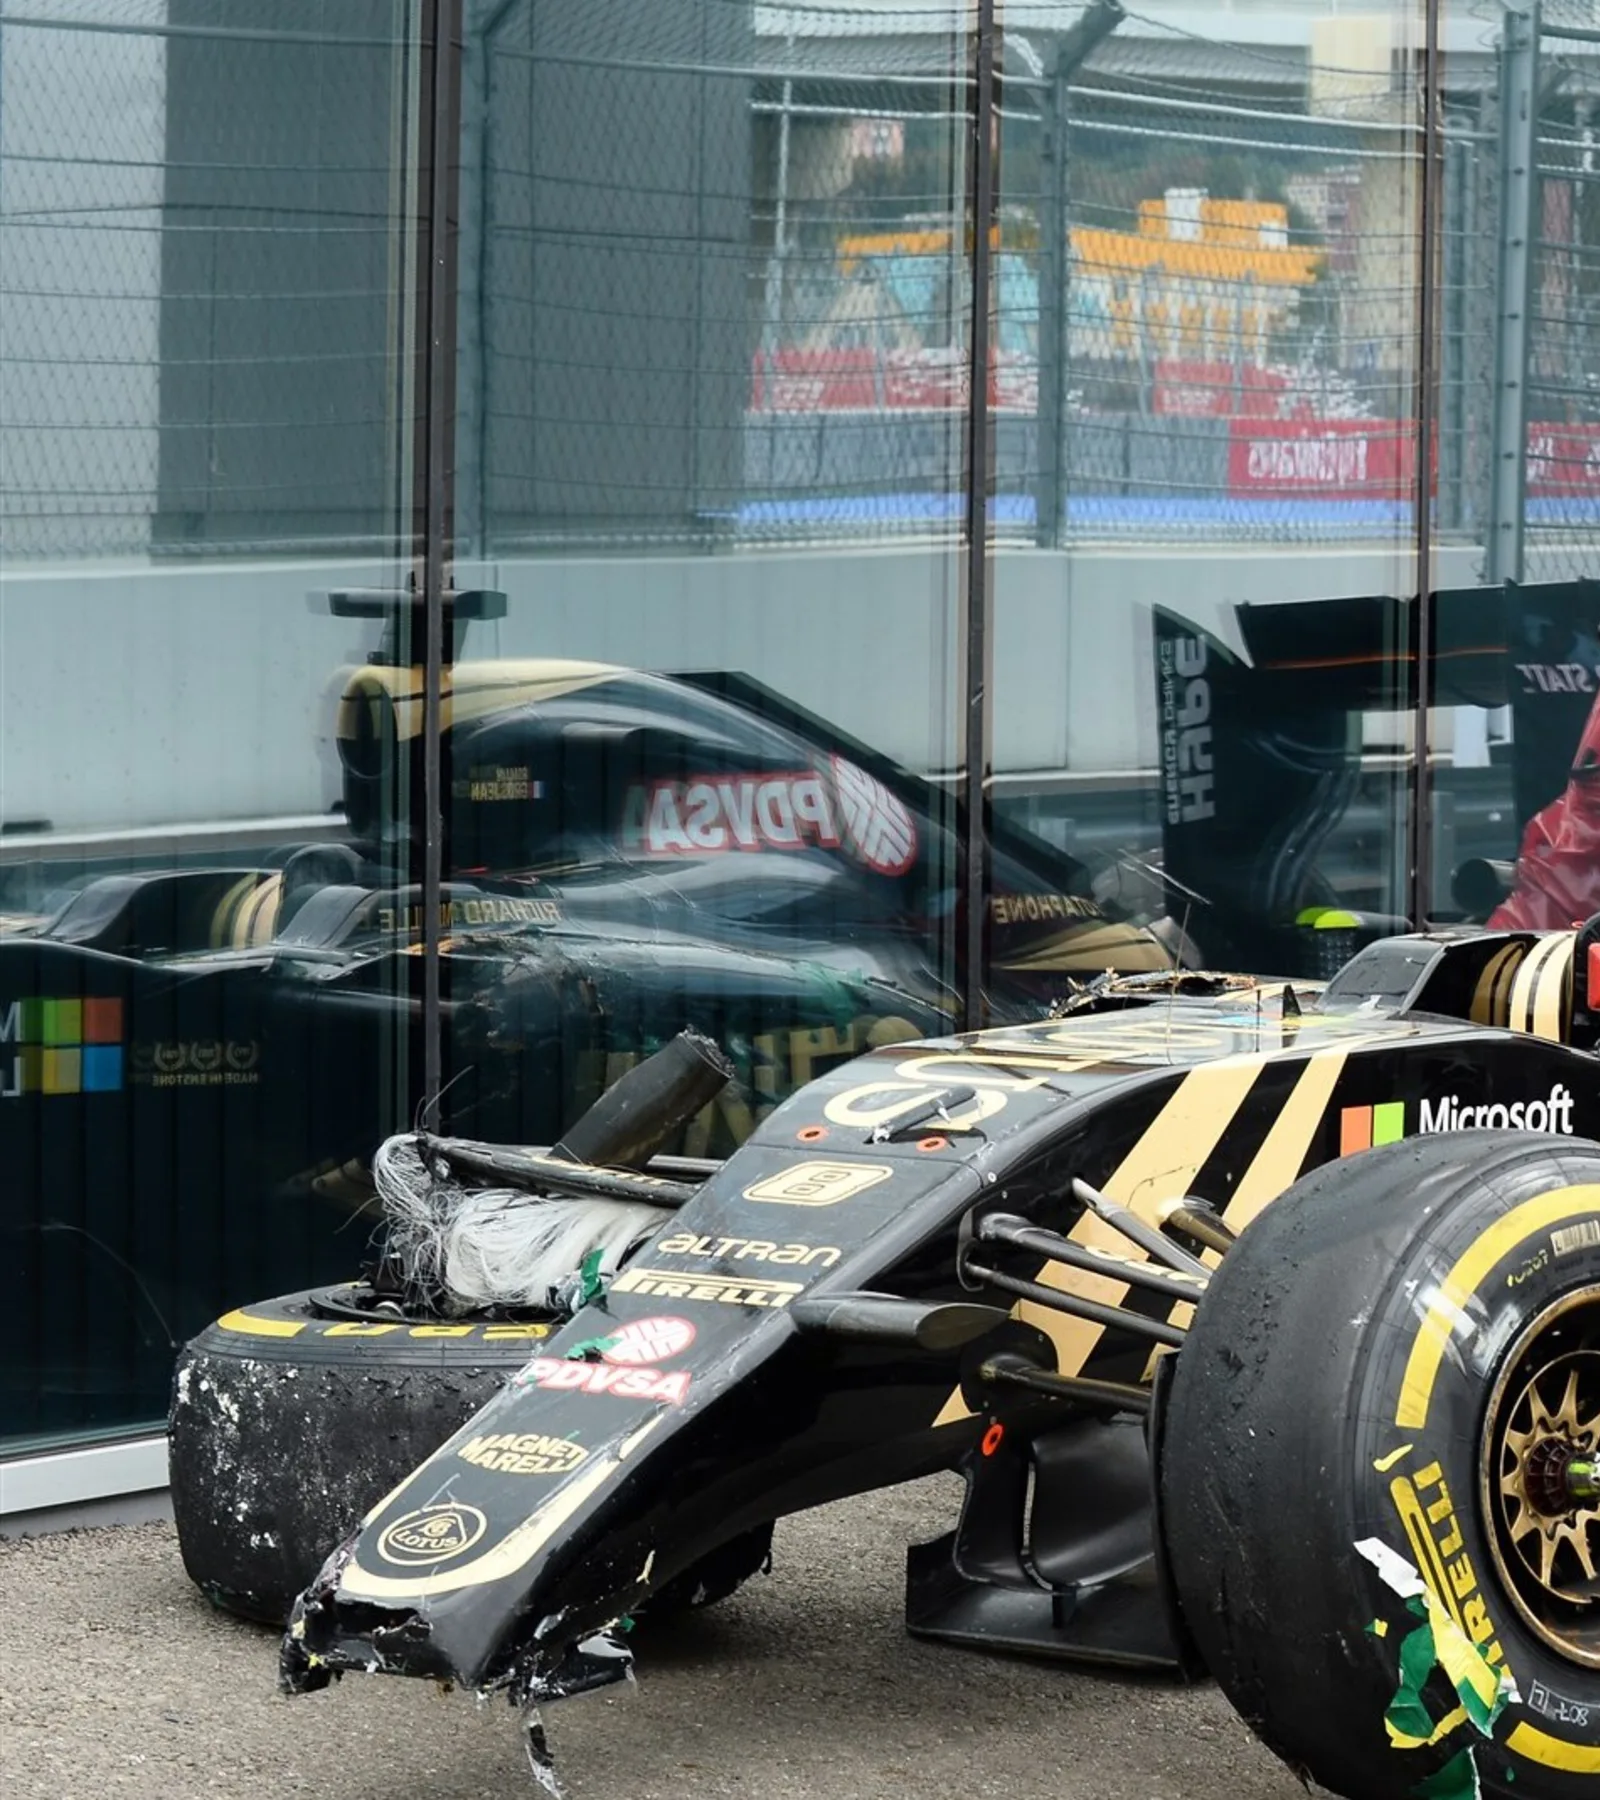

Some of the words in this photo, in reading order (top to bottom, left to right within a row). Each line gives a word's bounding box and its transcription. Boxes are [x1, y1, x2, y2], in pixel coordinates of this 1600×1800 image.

[1419, 1083, 1575, 1134] Microsoft
[610, 1267, 804, 1308] PIRELLI
[517, 1356, 692, 1405] PDVSA
[394, 1530, 459, 1550] LOTUS
